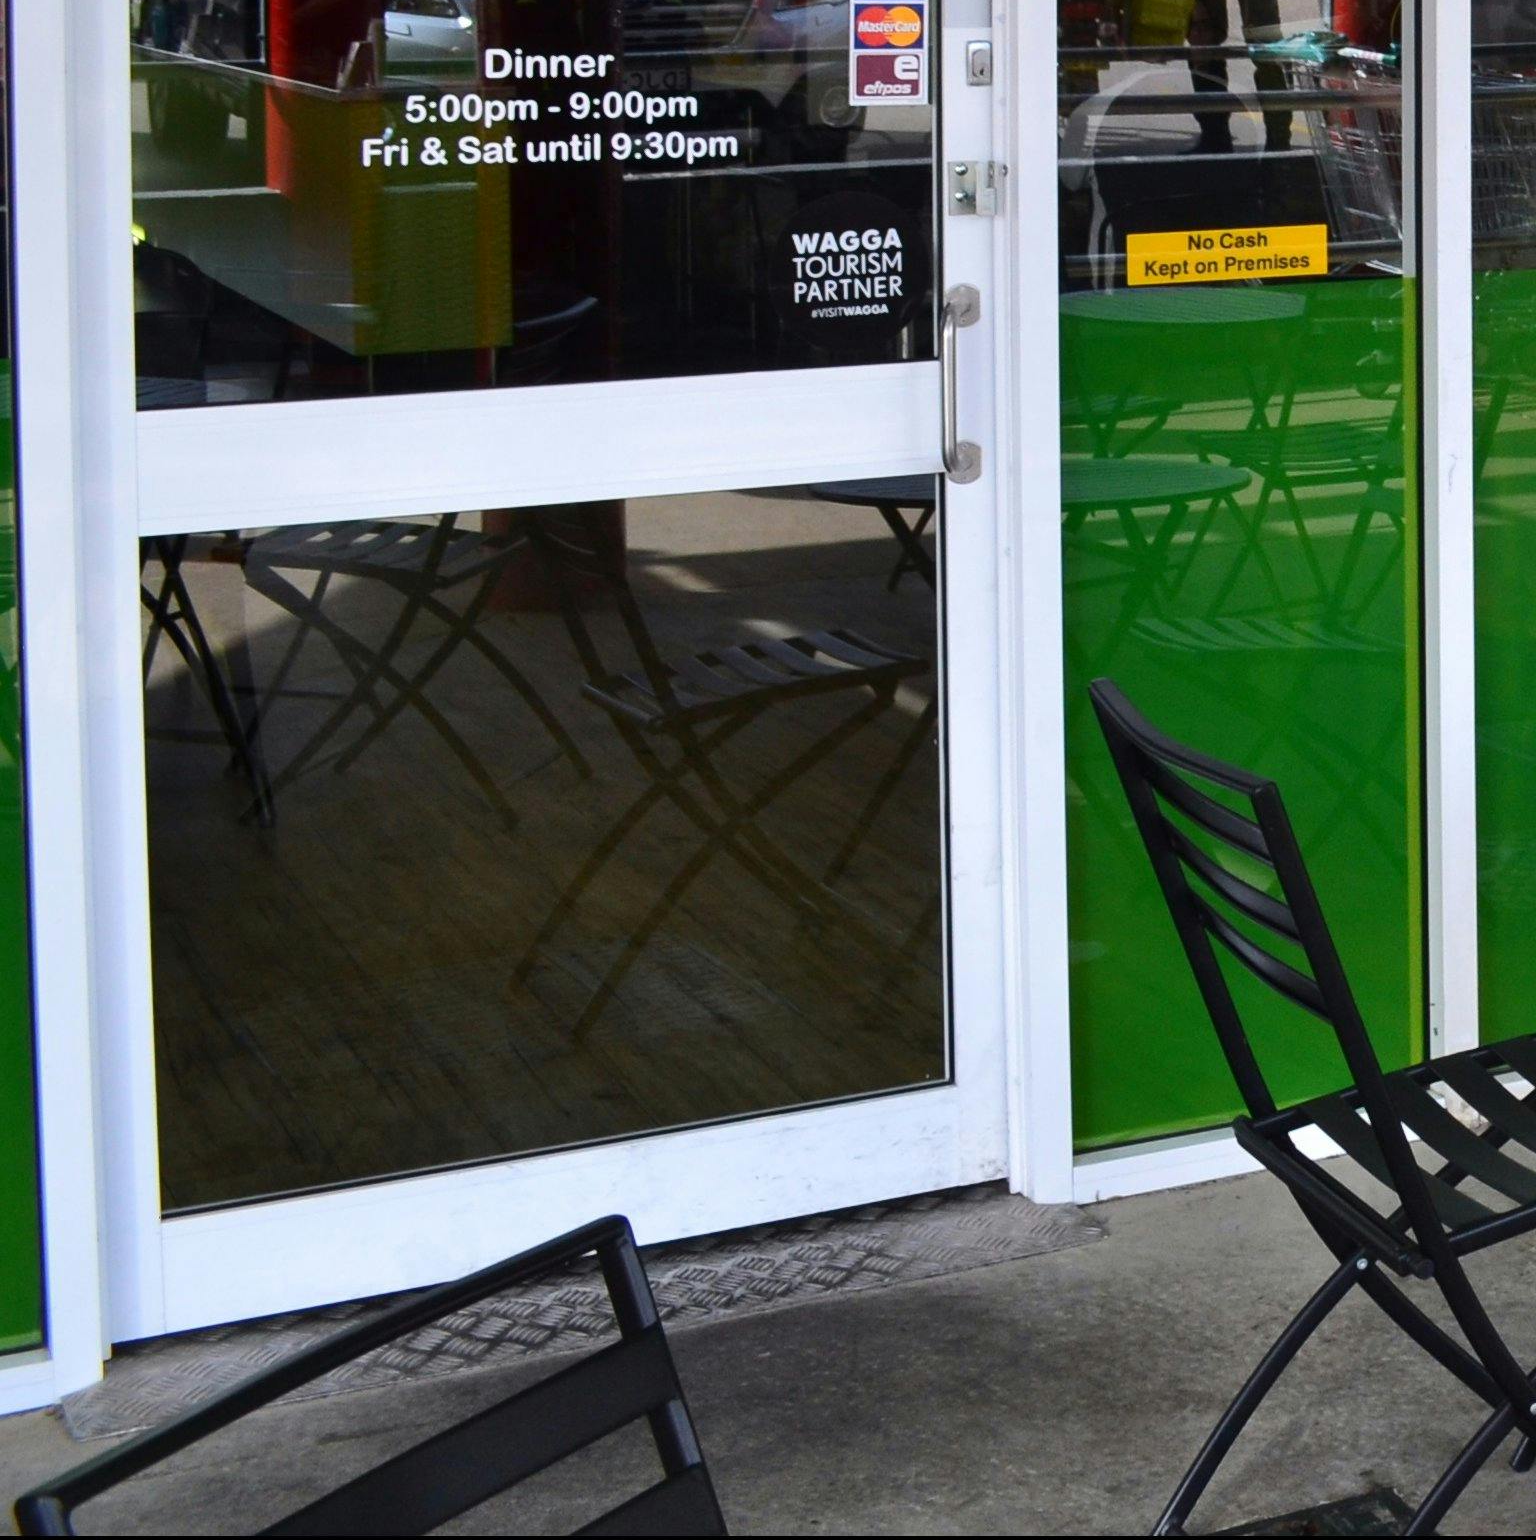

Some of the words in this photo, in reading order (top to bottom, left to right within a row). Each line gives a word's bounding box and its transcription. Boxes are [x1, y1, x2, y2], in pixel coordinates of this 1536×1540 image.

[857, 20, 921, 33] MasterCard
[484, 48, 616, 79] Dinner
[863, 80, 912, 97] eftpos
[405, 93, 539, 130] 5:00pm
[569, 90, 699, 125] 9:00pm
[362, 139, 409, 167] Fri
[420, 137, 448, 166] &
[458, 135, 518, 165] Sat
[526, 133, 602, 163] until
[611, 130, 739, 166] 9:30pm
[791, 227, 903, 255] WAGGA
[1186, 232, 1213, 250] No
[1218, 230, 1269, 250] Cash
[791, 250, 903, 279] TOURISM
[1143, 257, 1189, 280] Kept
[1194, 260, 1219, 275] on
[1224, 253, 1311, 273] Premises
[793, 275, 904, 304] PARTNER
[811, 303, 889, 319] #VISITWAGGA
